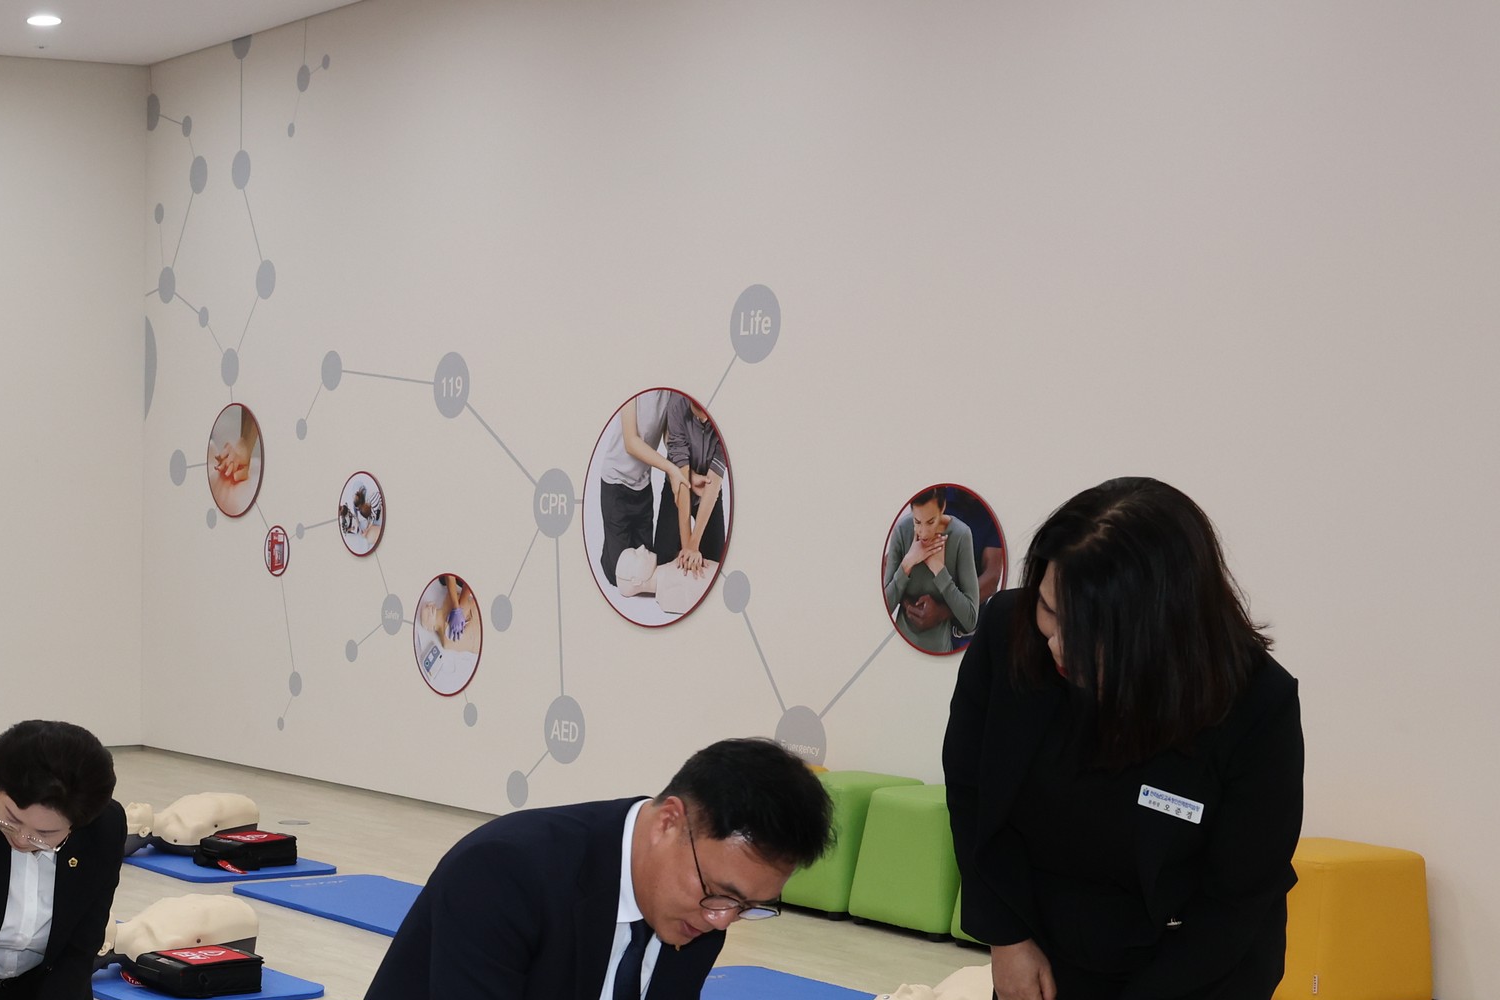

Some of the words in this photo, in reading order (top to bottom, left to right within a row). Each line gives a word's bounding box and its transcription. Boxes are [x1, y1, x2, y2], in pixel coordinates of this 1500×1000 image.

[740, 310, 771, 335] Life
[442, 376, 462, 397] 119
[540, 493, 567, 515] CPR
[550, 720, 578, 742] AED
